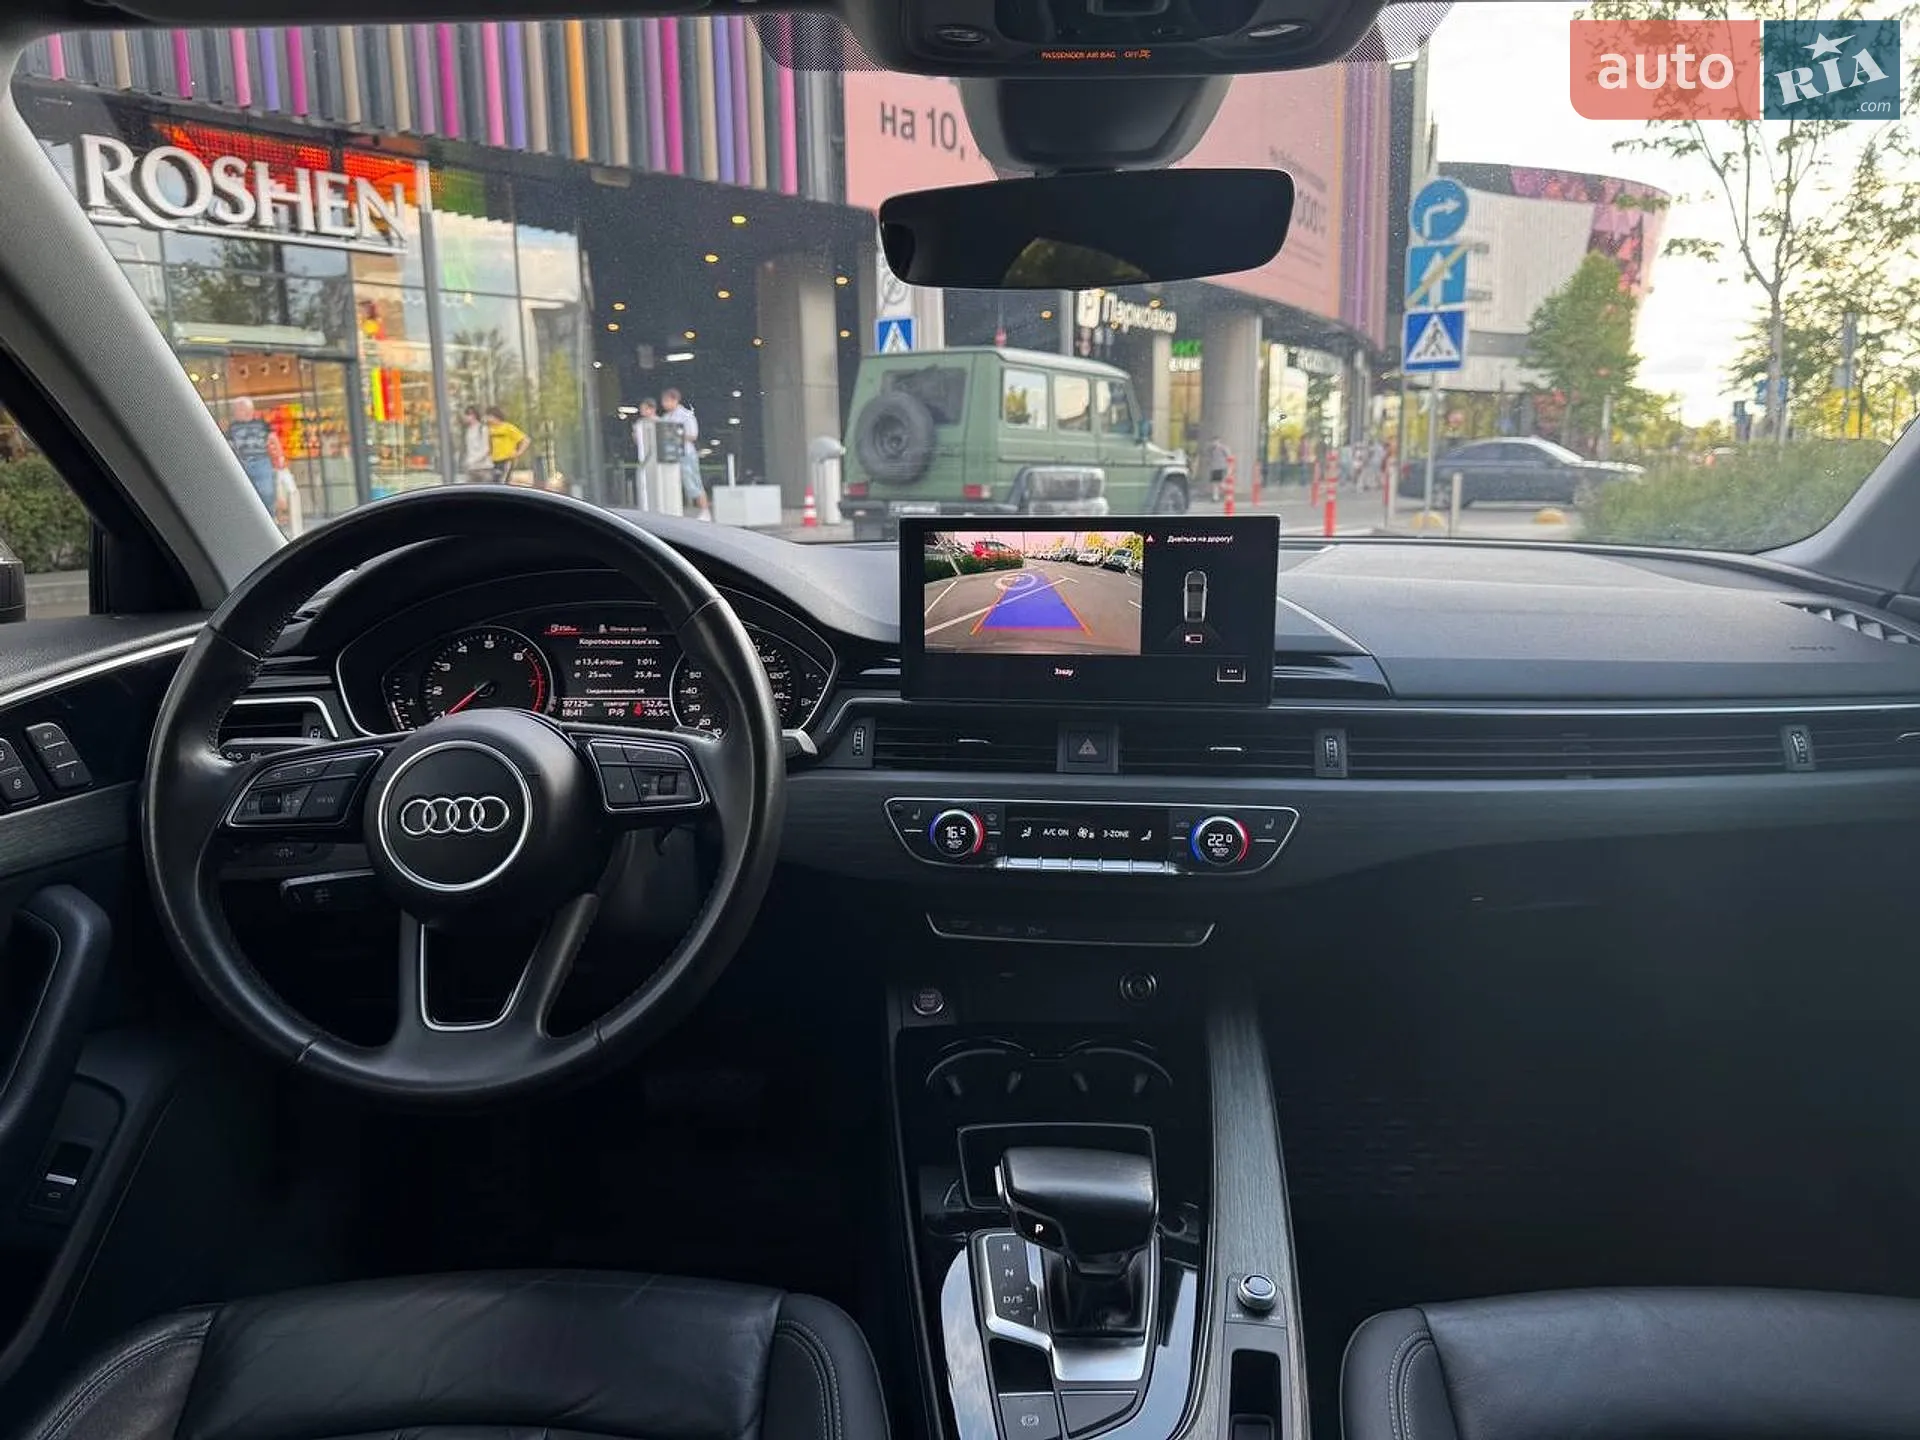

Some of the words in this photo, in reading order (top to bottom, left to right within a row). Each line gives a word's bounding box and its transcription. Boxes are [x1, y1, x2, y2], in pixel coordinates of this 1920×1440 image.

[1041, 51, 1085, 59] PASSENGER
[1086, 51, 1099, 59] AIR
[1099, 51, 1116, 59] BAG
[880, 100, 915, 141] На
[926, 107, 965, 161] 10,
[81, 133, 409, 250] ROSHEN
[1102, 292, 1177, 334] Парковка
[457, 645, 468, 653] 4
[484, 641, 495, 649] 5
[512, 652, 524, 661] 6
[441, 662, 451, 672] 3
[431, 686, 443, 695] 2
[686, 686, 698, 694] 40
[688, 704, 701, 712] 30
[699, 718, 711, 726] 20
[1042, 828, 1057, 836] A/C
[1058, 828, 1069, 836] ON
[1102, 830, 1130, 838] 3-ZONE
[1034, 1223, 1044, 1234] P
[1004, 1268, 1015, 1278] N
